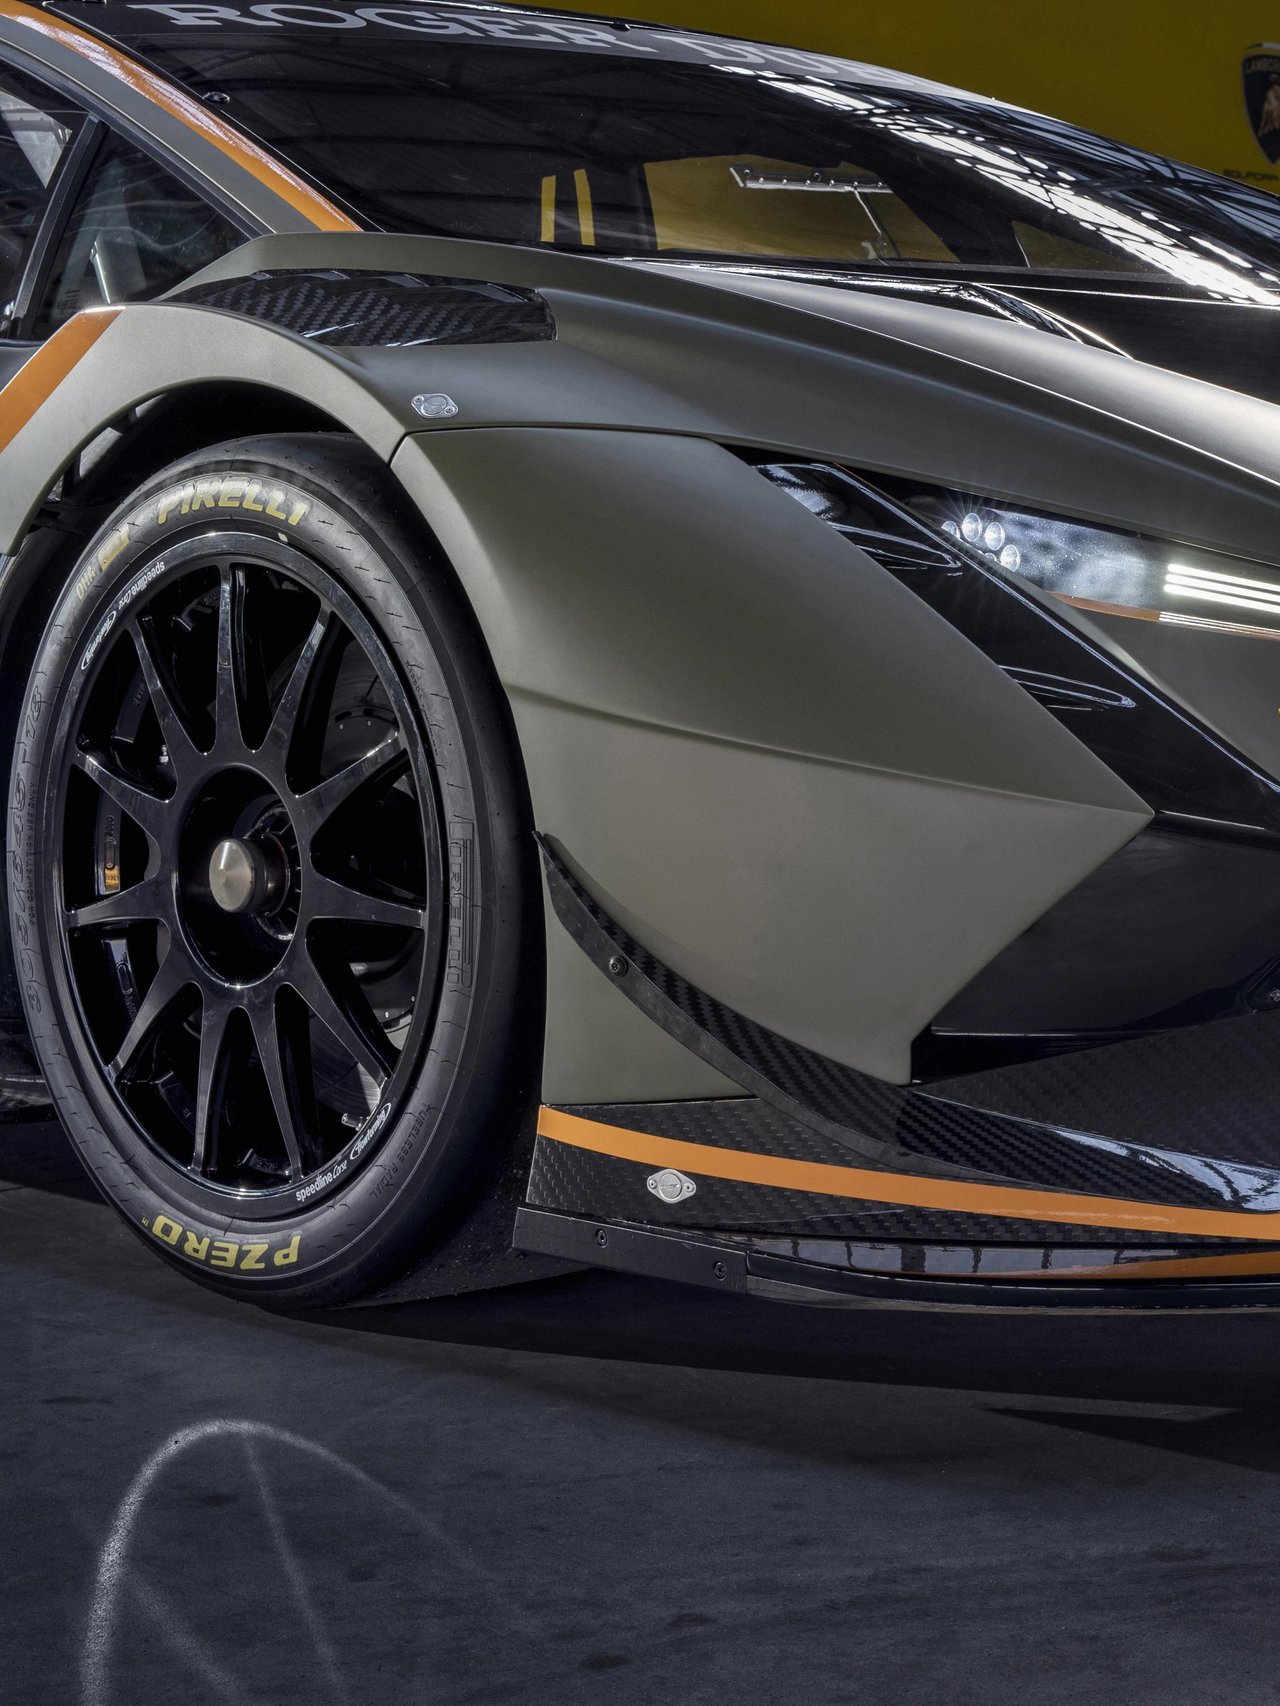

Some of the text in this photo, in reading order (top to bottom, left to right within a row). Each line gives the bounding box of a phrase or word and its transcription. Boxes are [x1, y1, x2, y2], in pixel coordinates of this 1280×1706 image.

[129, 3, 658, 53] ROGER
[157, 477, 311, 527] PIRELLI
[75, 565, 97, 600] DHA
[446, 821, 475, 991] PIRELLI
[397, 1102, 436, 1163] TUBELESS
[295, 1173, 333, 1202] speedline
